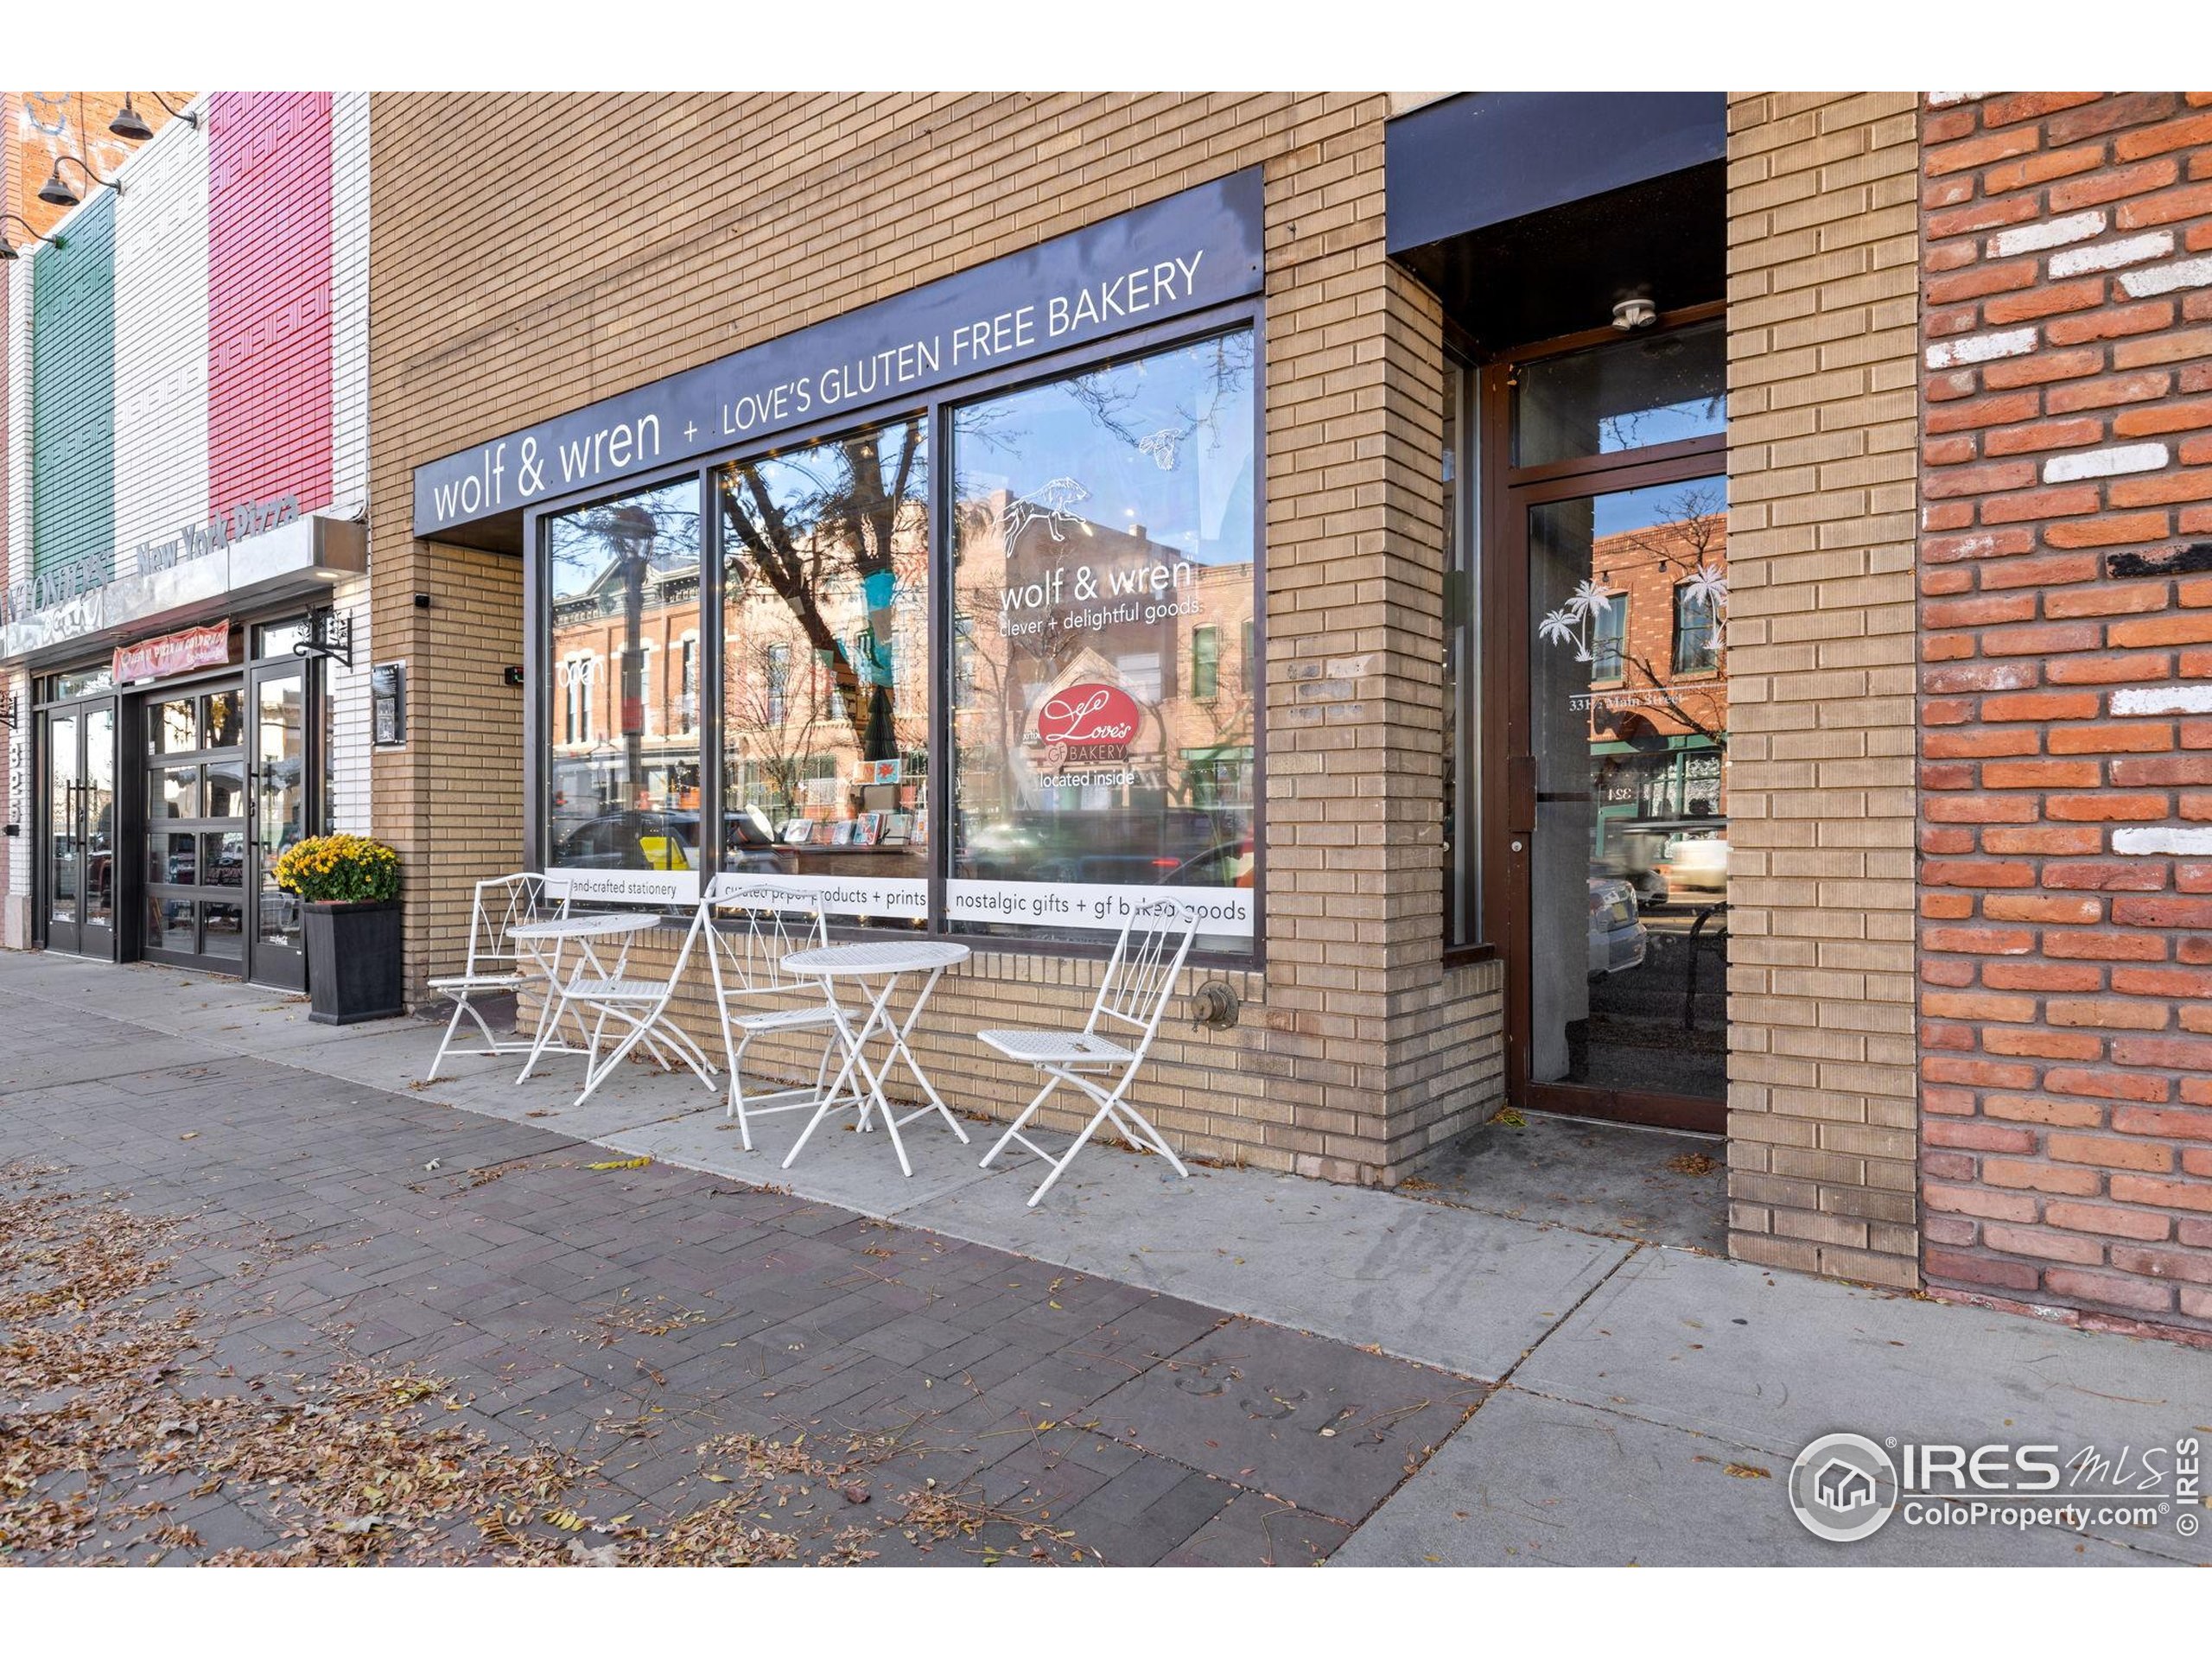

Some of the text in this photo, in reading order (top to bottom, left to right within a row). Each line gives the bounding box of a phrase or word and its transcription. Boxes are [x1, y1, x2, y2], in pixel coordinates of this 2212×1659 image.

[434, 443, 506, 521] wolf
[518, 436, 545, 496] &
[559, 414, 659, 482] wren
[724, 378, 810, 435] LOVE'S
[819, 335, 940, 404] GLUTEN
[952, 306, 1035, 365] FREE
[1049, 251, 1204, 337] BAKERY
[137, 540, 178, 576] New
[181, 510, 230, 562] York
[1000, 561, 1192, 611] wolf & wren
[999, 619, 1043, 638] clever
[1064, 601, 1139, 632] delightful
[1145, 595, 1200, 625] goods
[558, 655, 604, 690] open
[1045, 690, 1132, 742] Love's
[1606, 697, 1641, 709] Main
[1048, 743, 1125, 763] GF BAKERY
[1039, 770, 1135, 788] located inside
[570, 878, 677, 899] and-crafted stationery
[887, 890, 927, 909] prints
[956, 891, 1027, 914] nostalgic
[1033, 893, 1069, 916] gifts
[1095, 896, 1112, 920] gf
[1119, 897, 1176, 918] bked
